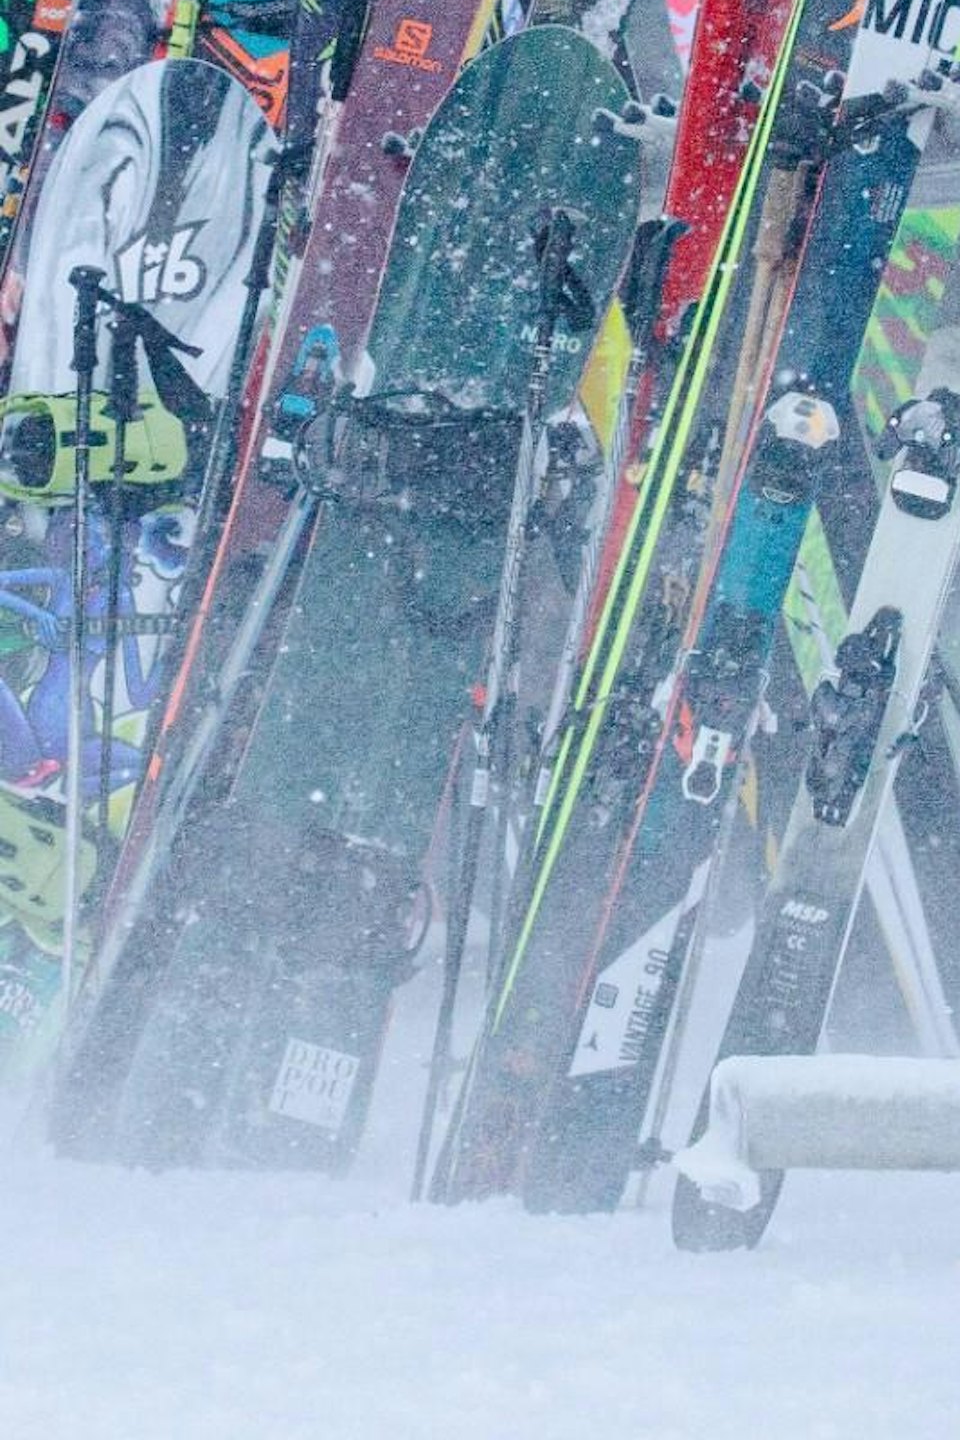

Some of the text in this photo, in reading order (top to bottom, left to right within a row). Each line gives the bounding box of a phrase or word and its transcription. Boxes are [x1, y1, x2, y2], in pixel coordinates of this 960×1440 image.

[115, 222, 207, 300] lib
[520, 324, 582, 354] NRO
[618, 984, 656, 1061] VANTAGE
